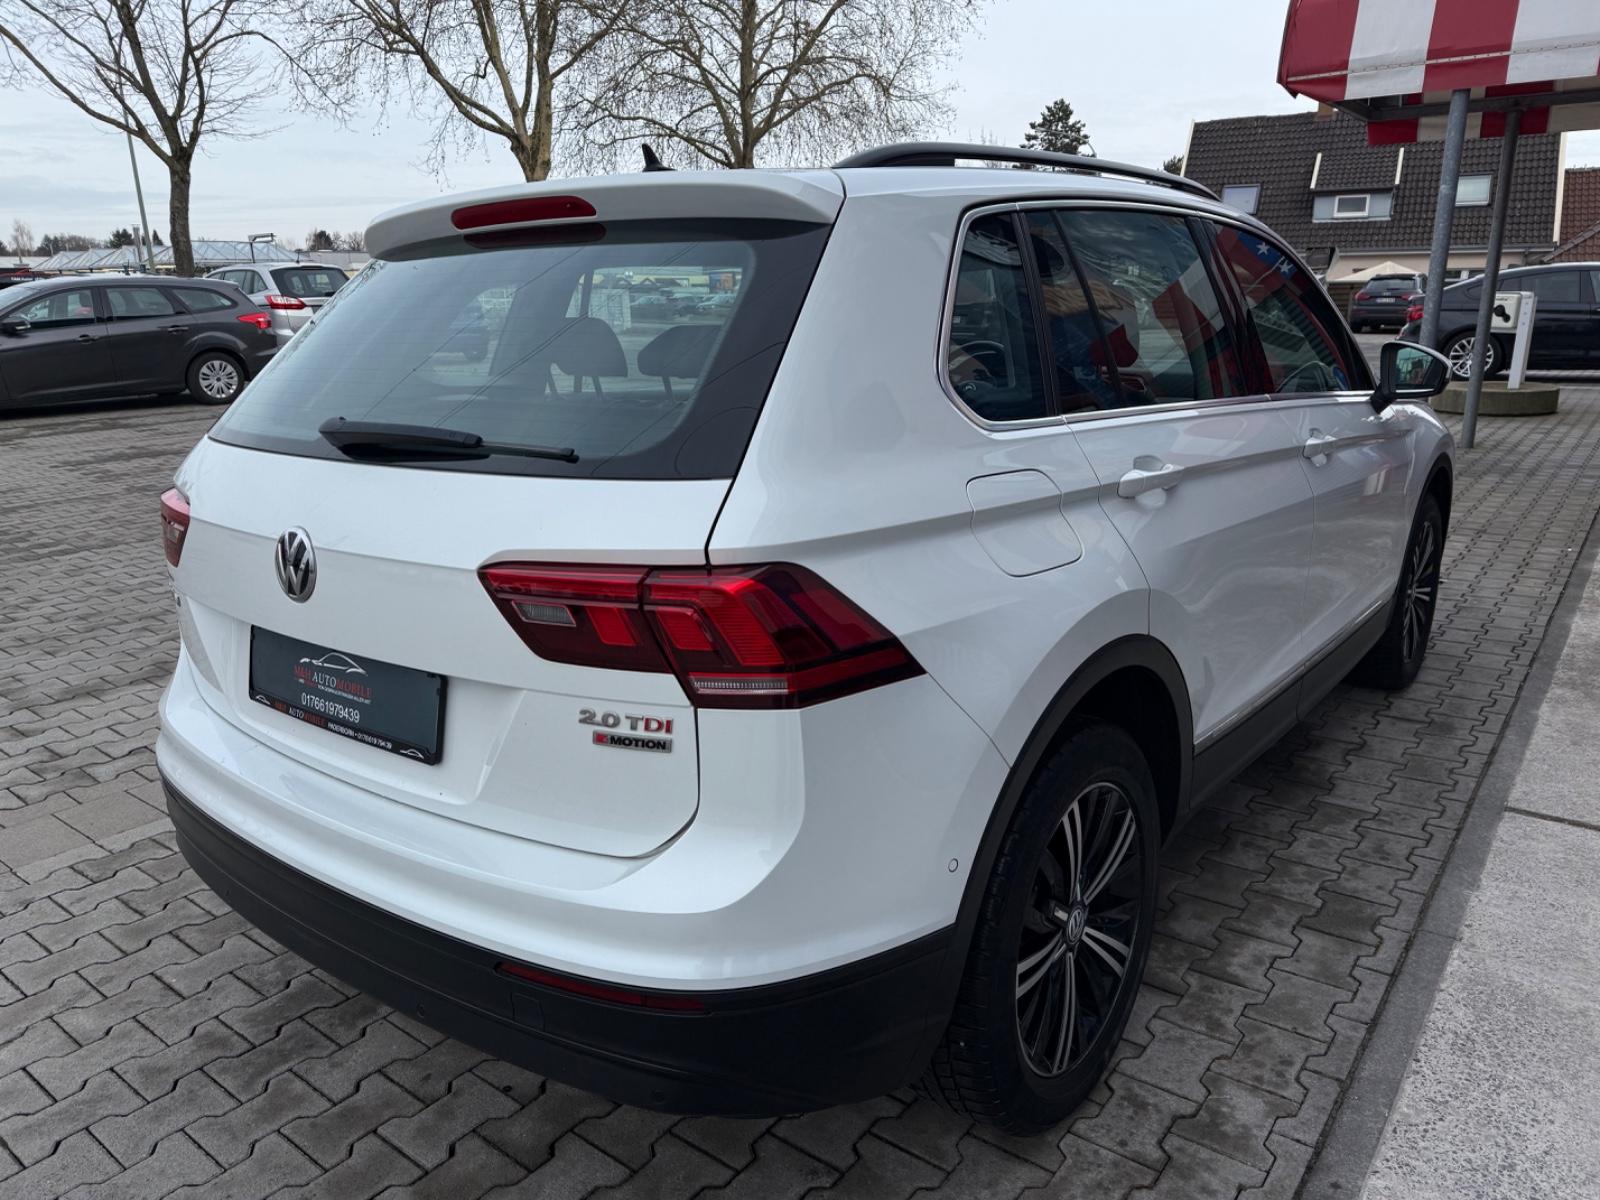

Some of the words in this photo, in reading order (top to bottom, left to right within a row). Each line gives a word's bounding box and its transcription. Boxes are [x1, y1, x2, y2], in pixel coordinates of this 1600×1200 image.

[302, 692, 360, 724] 017661979439
[578, 708, 621, 729] 2.0
[625, 713, 673, 734] TDI
